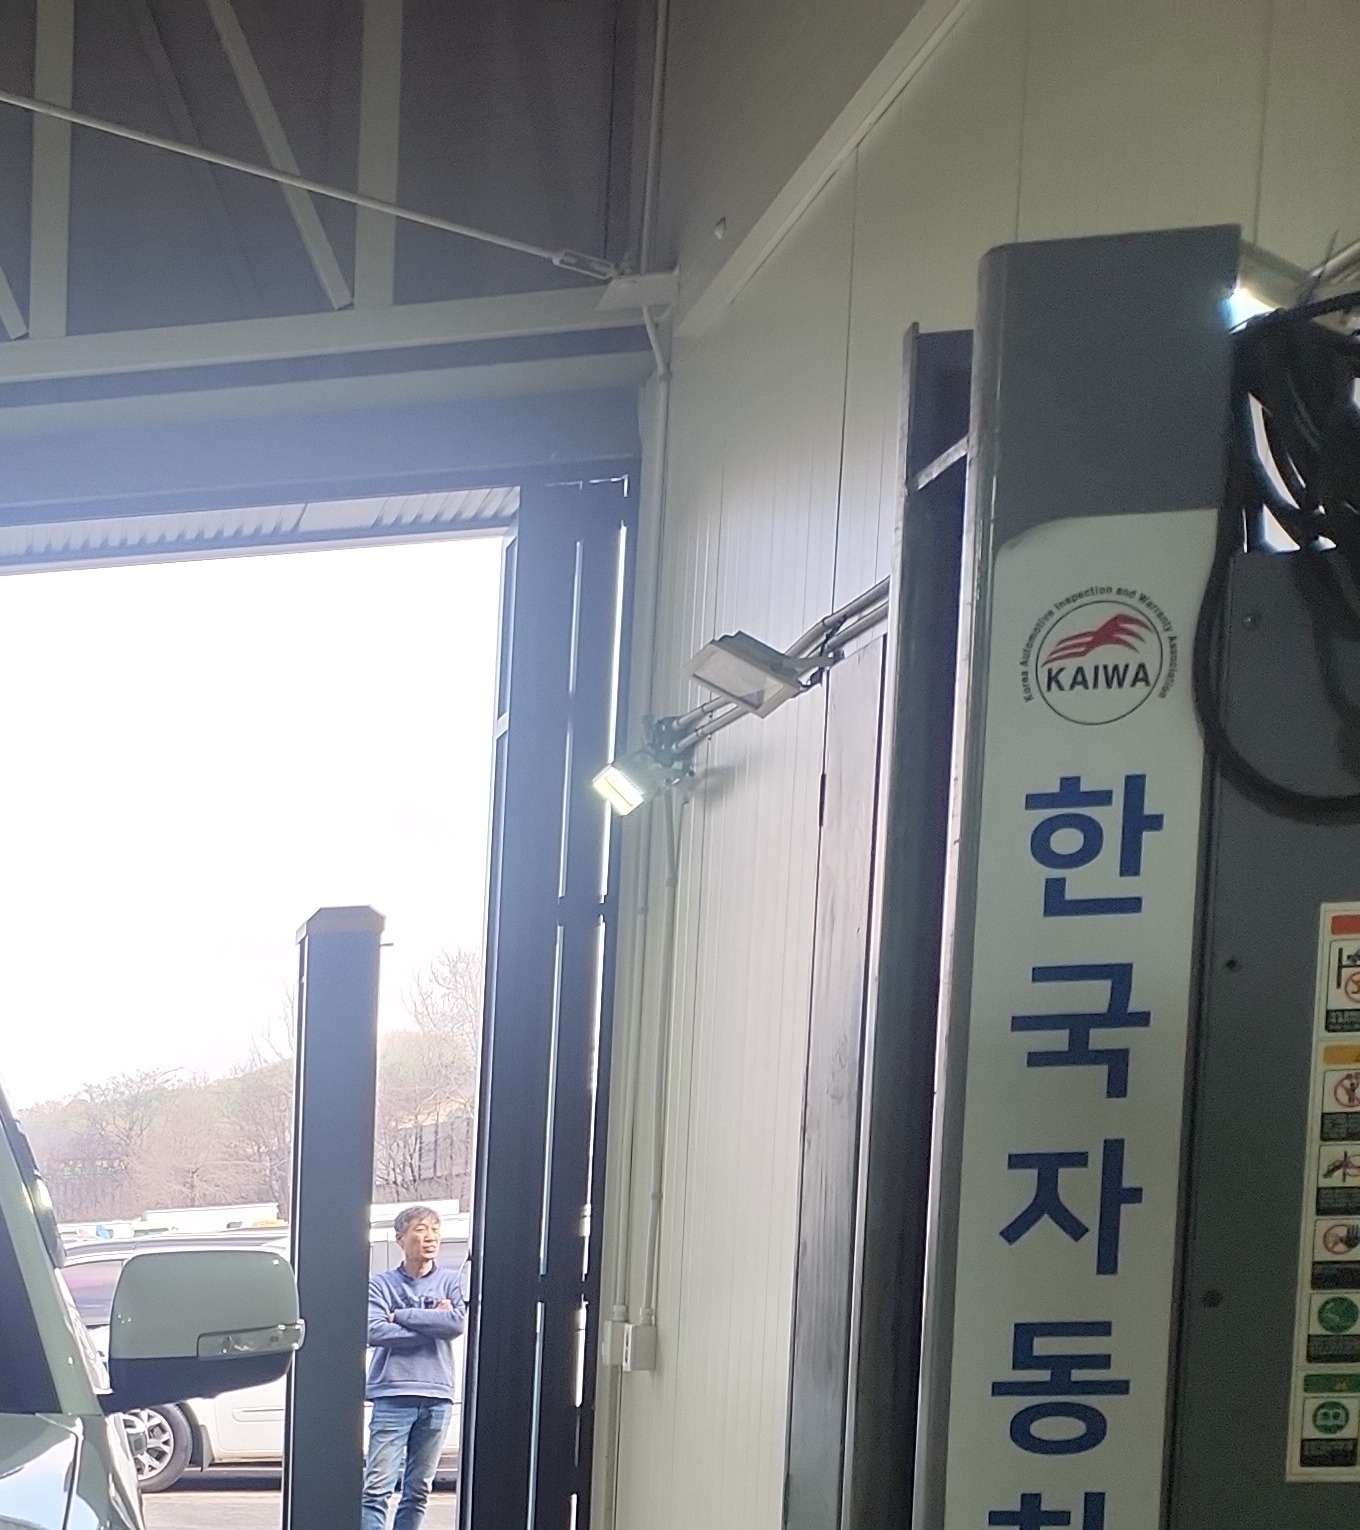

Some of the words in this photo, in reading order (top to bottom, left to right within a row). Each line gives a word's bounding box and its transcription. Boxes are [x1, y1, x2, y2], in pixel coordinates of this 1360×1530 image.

[1020, 670, 1034, 703] Korea
[1053, 586, 1113, 611] Inspection
[1115, 587, 1138, 600] and
[1138, 593, 1174, 633] Warranty
[1046, 661, 1152, 693] KAIWA
